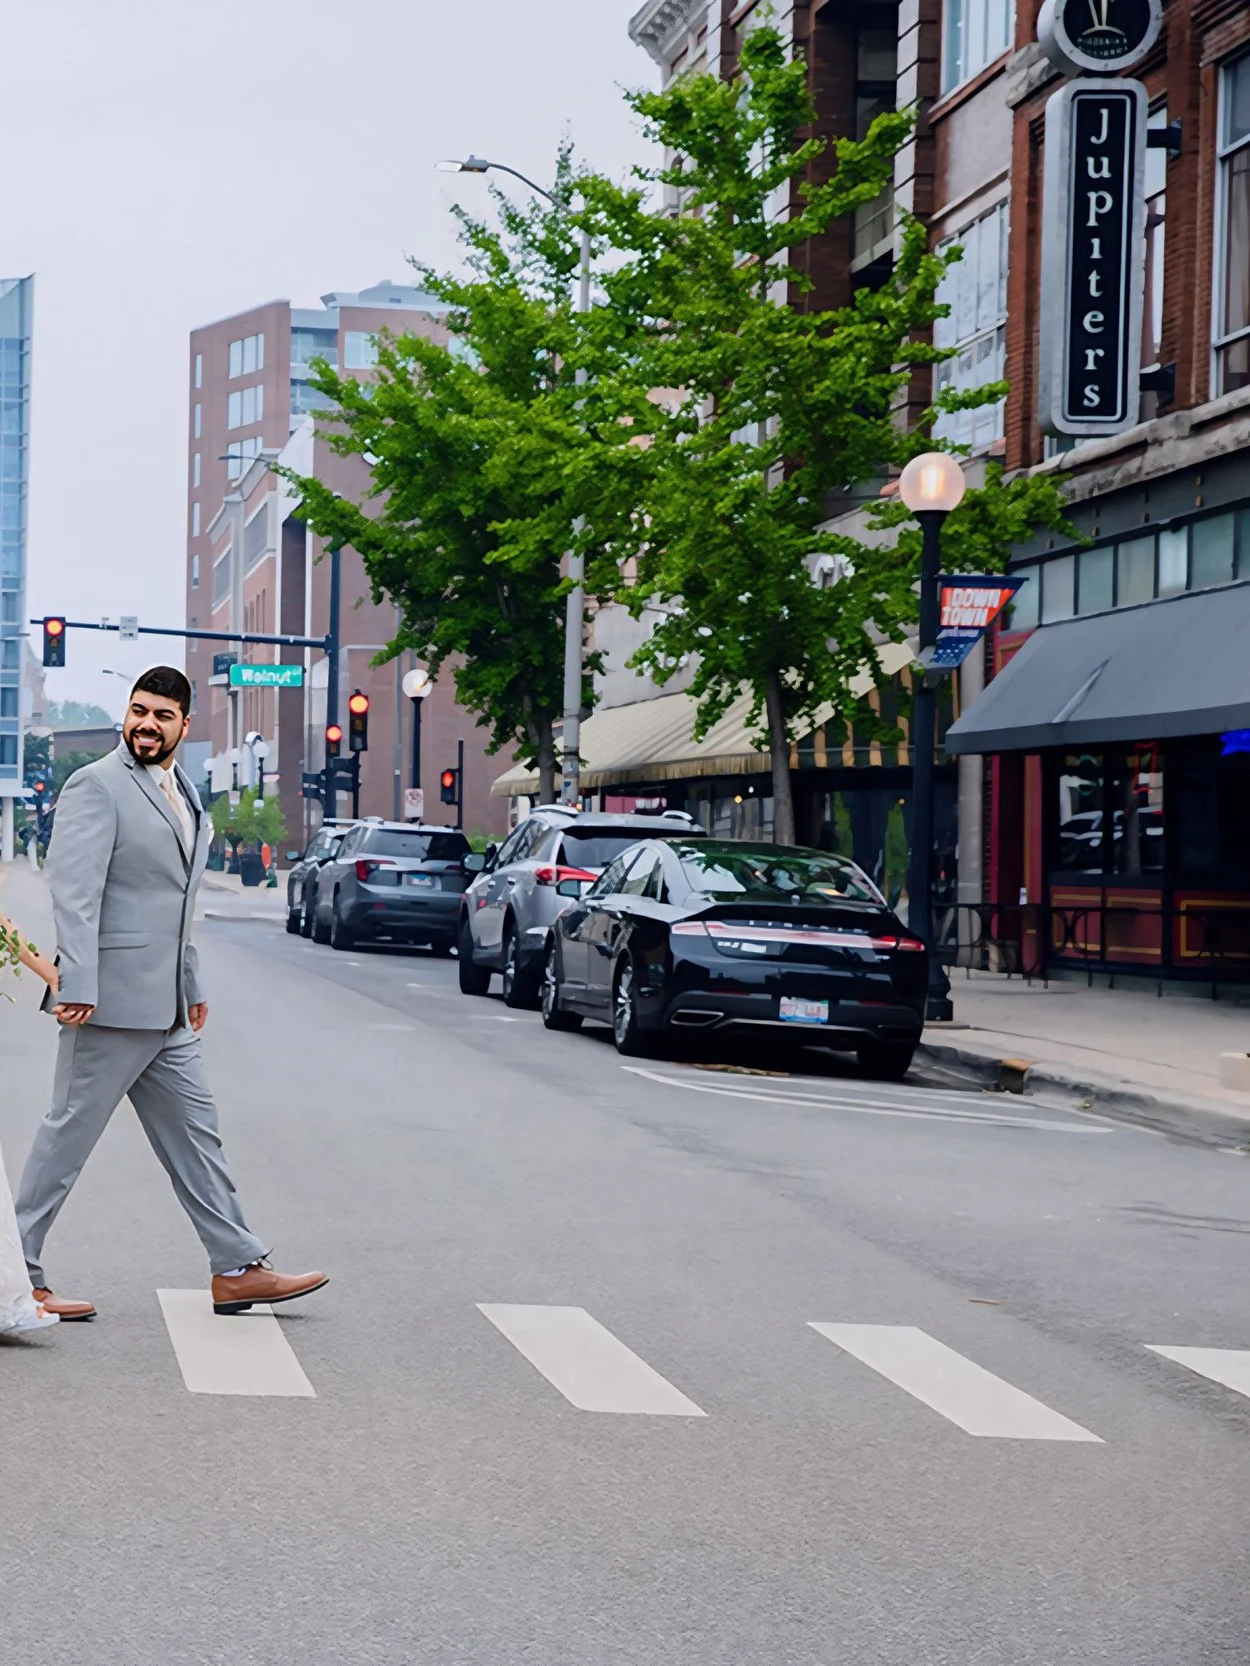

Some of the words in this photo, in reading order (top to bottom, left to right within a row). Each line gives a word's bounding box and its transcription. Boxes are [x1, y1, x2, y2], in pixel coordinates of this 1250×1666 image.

[1083, 108, 1113, 408] Jupiters
[951, 588, 1002, 609] DOWN
[941, 606, 989, 627] TOWN
[241, 668, 291, 684] Walnut
